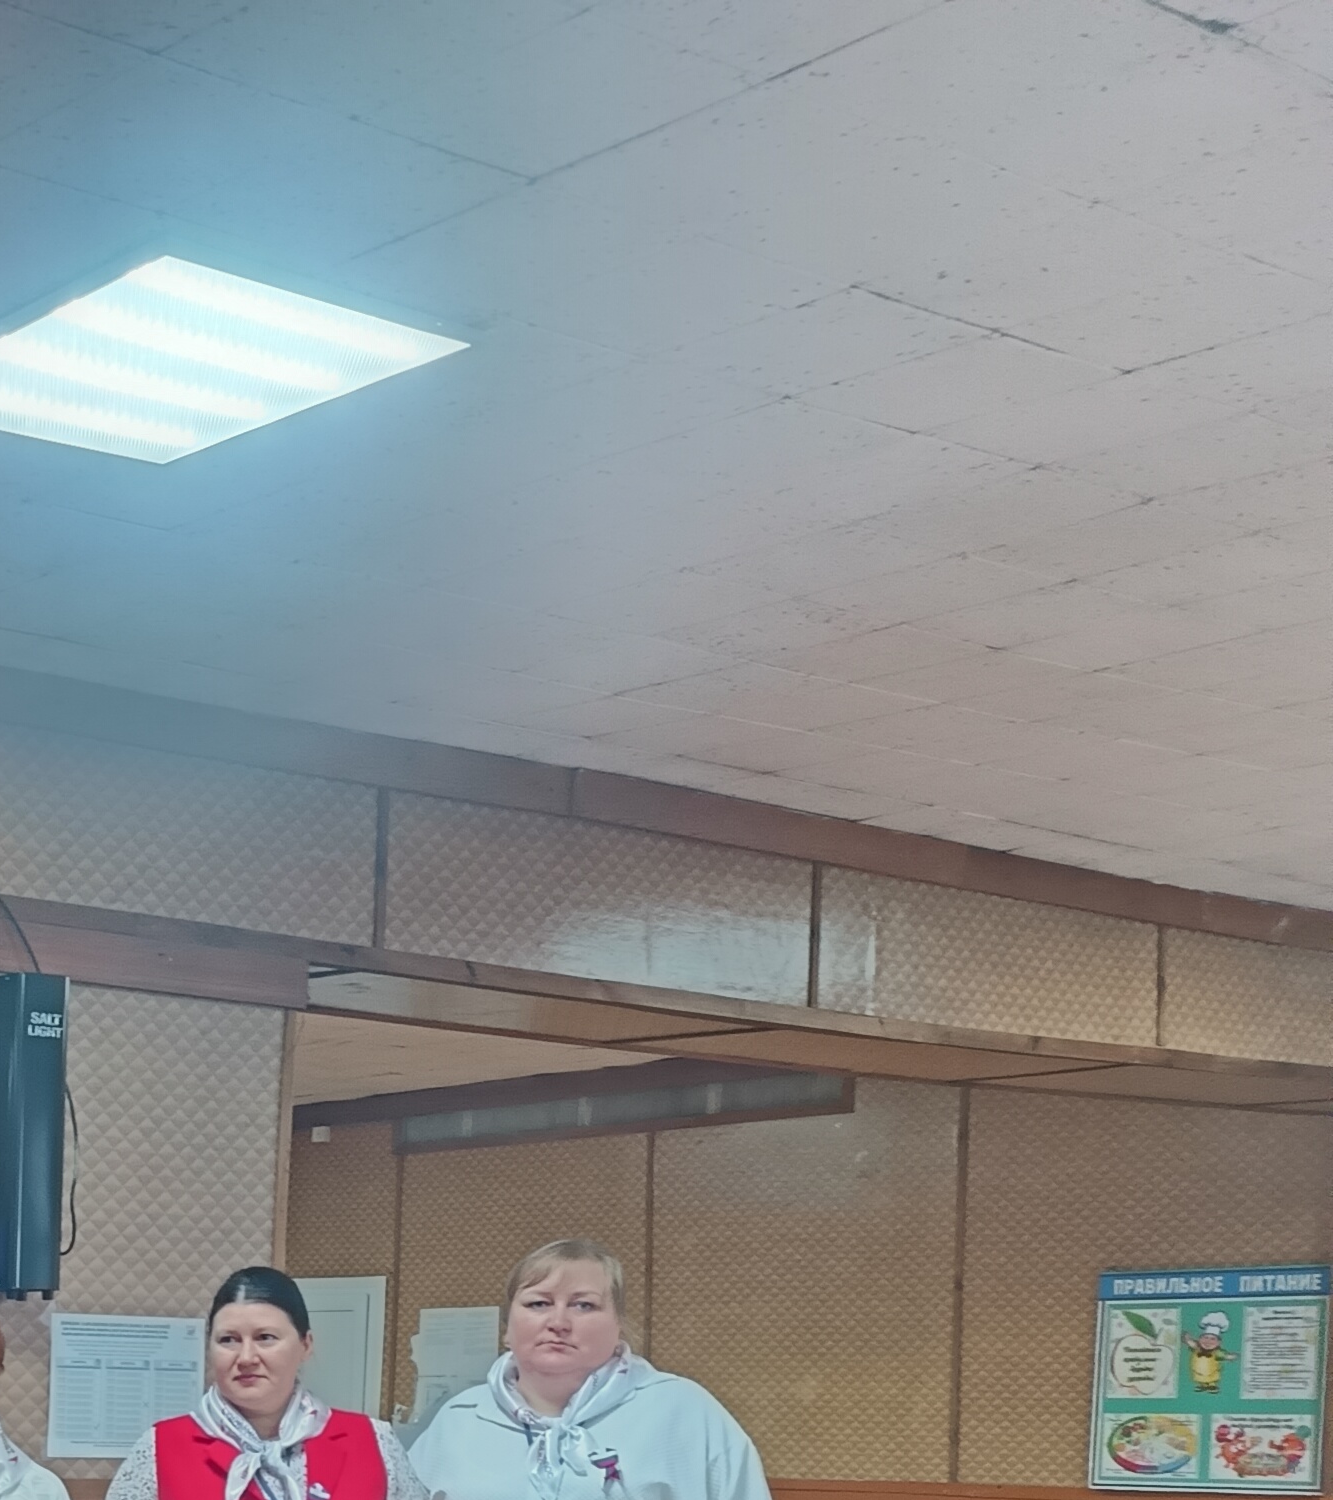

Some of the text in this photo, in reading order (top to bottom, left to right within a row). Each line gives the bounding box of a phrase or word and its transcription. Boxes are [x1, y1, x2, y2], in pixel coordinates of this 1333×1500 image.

[30, 1012, 62, 1025] SALT
[28, 1025, 63, 1038] LIGHT
[1113, 1274, 1322, 1295] ПРАВИЛЬНОЕ ПИТАНИЕ
